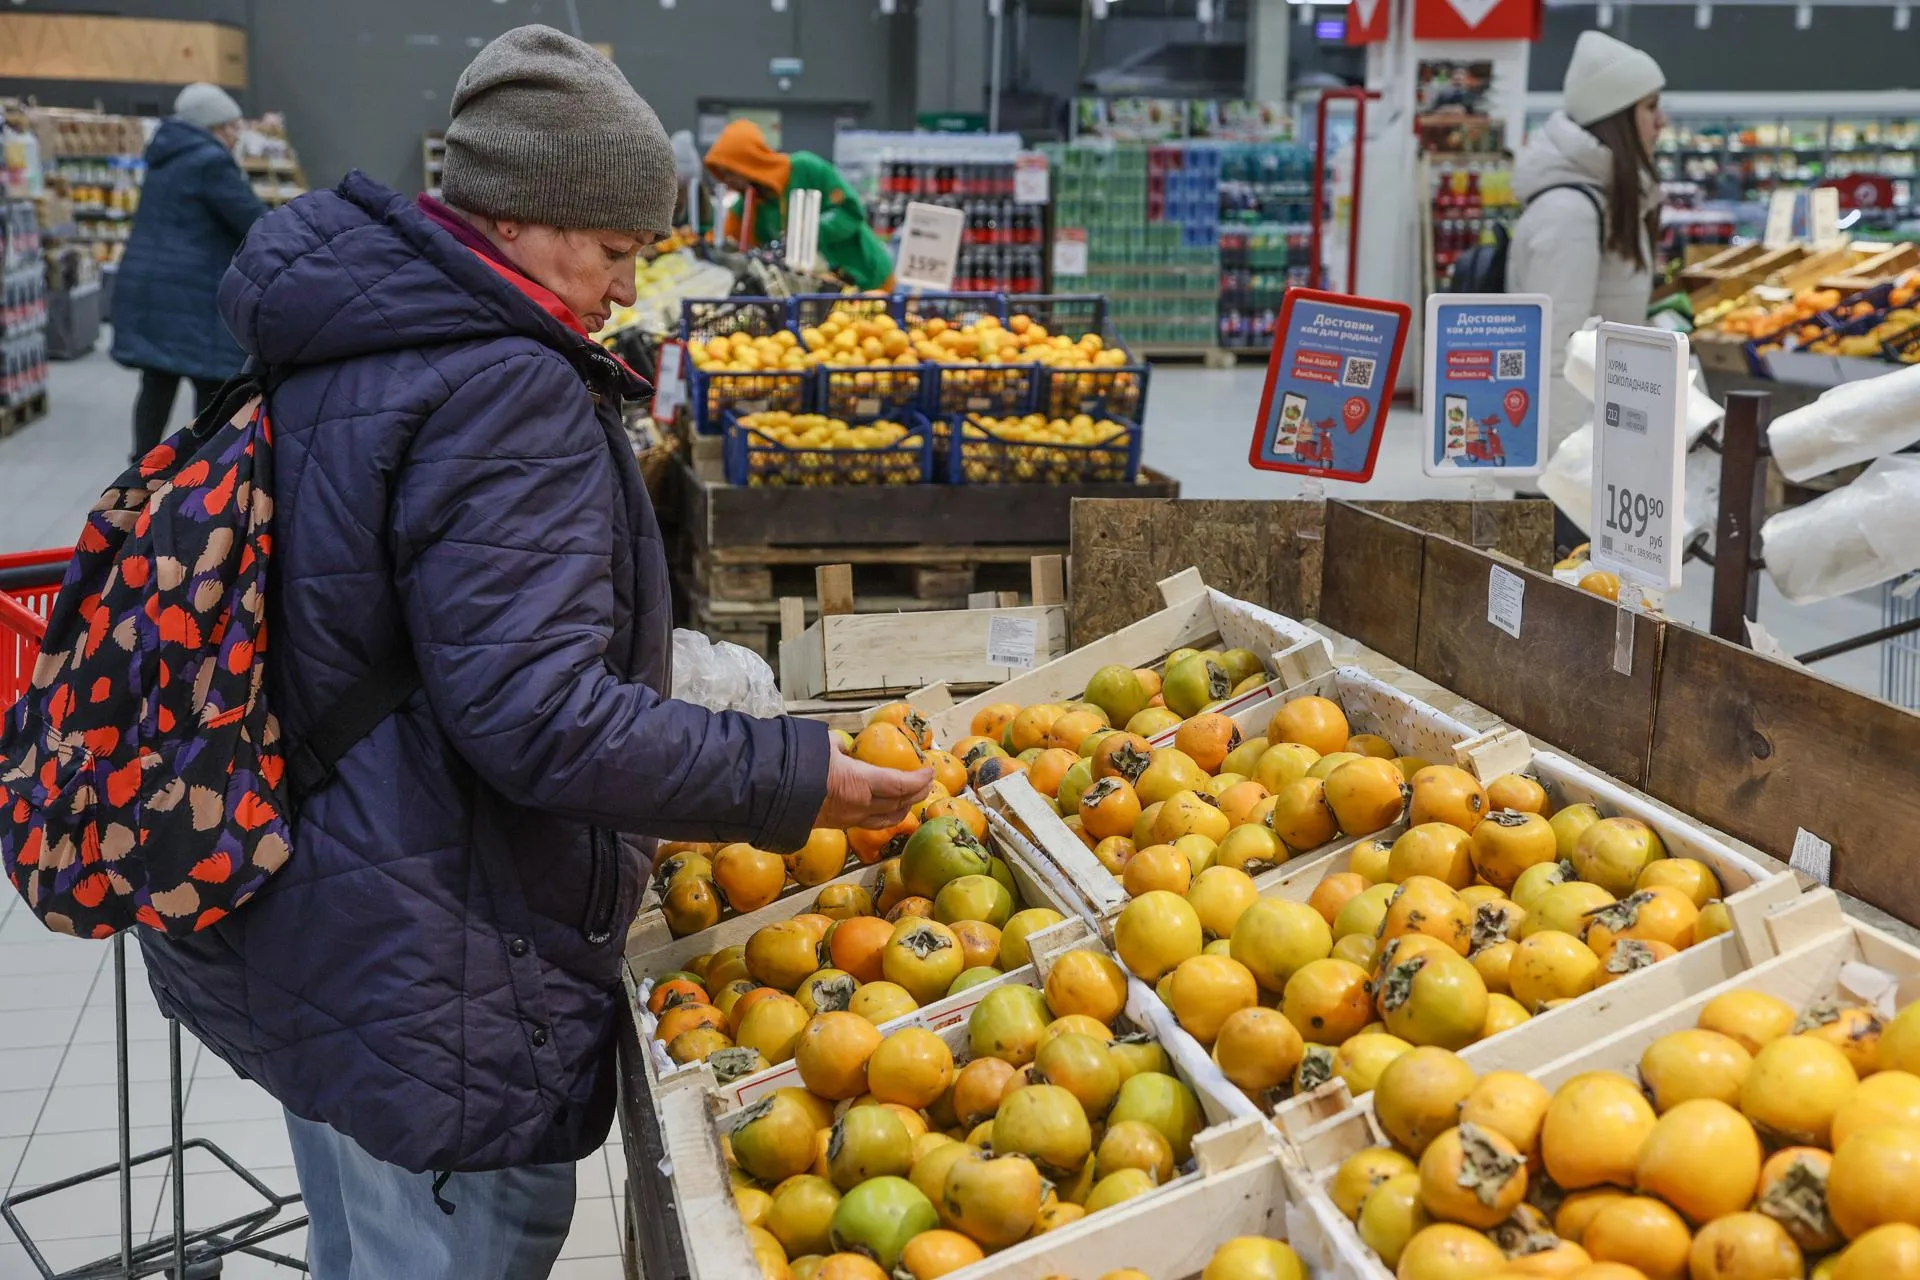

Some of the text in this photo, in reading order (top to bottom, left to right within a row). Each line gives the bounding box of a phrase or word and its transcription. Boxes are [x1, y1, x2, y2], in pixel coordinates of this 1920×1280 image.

[1313, 313, 1375, 332] Доставим
[1457, 312, 1516, 325] Доставим
[1301, 325, 1383, 344] как для родных!
[1465, 327, 1484, 336] для
[1485, 324, 1526, 336] родных!
[1607, 359, 1628, 373] ХУРМА
[1295, 369, 1333, 381] Auchan.ru
[1607, 373, 1662, 396] ШОКОЛАДНАЯ ВЕС
[1607, 408, 1618, 422] 212
[1606, 484, 1664, 538] 189 90
[1649, 535, 1663, 549] руб
